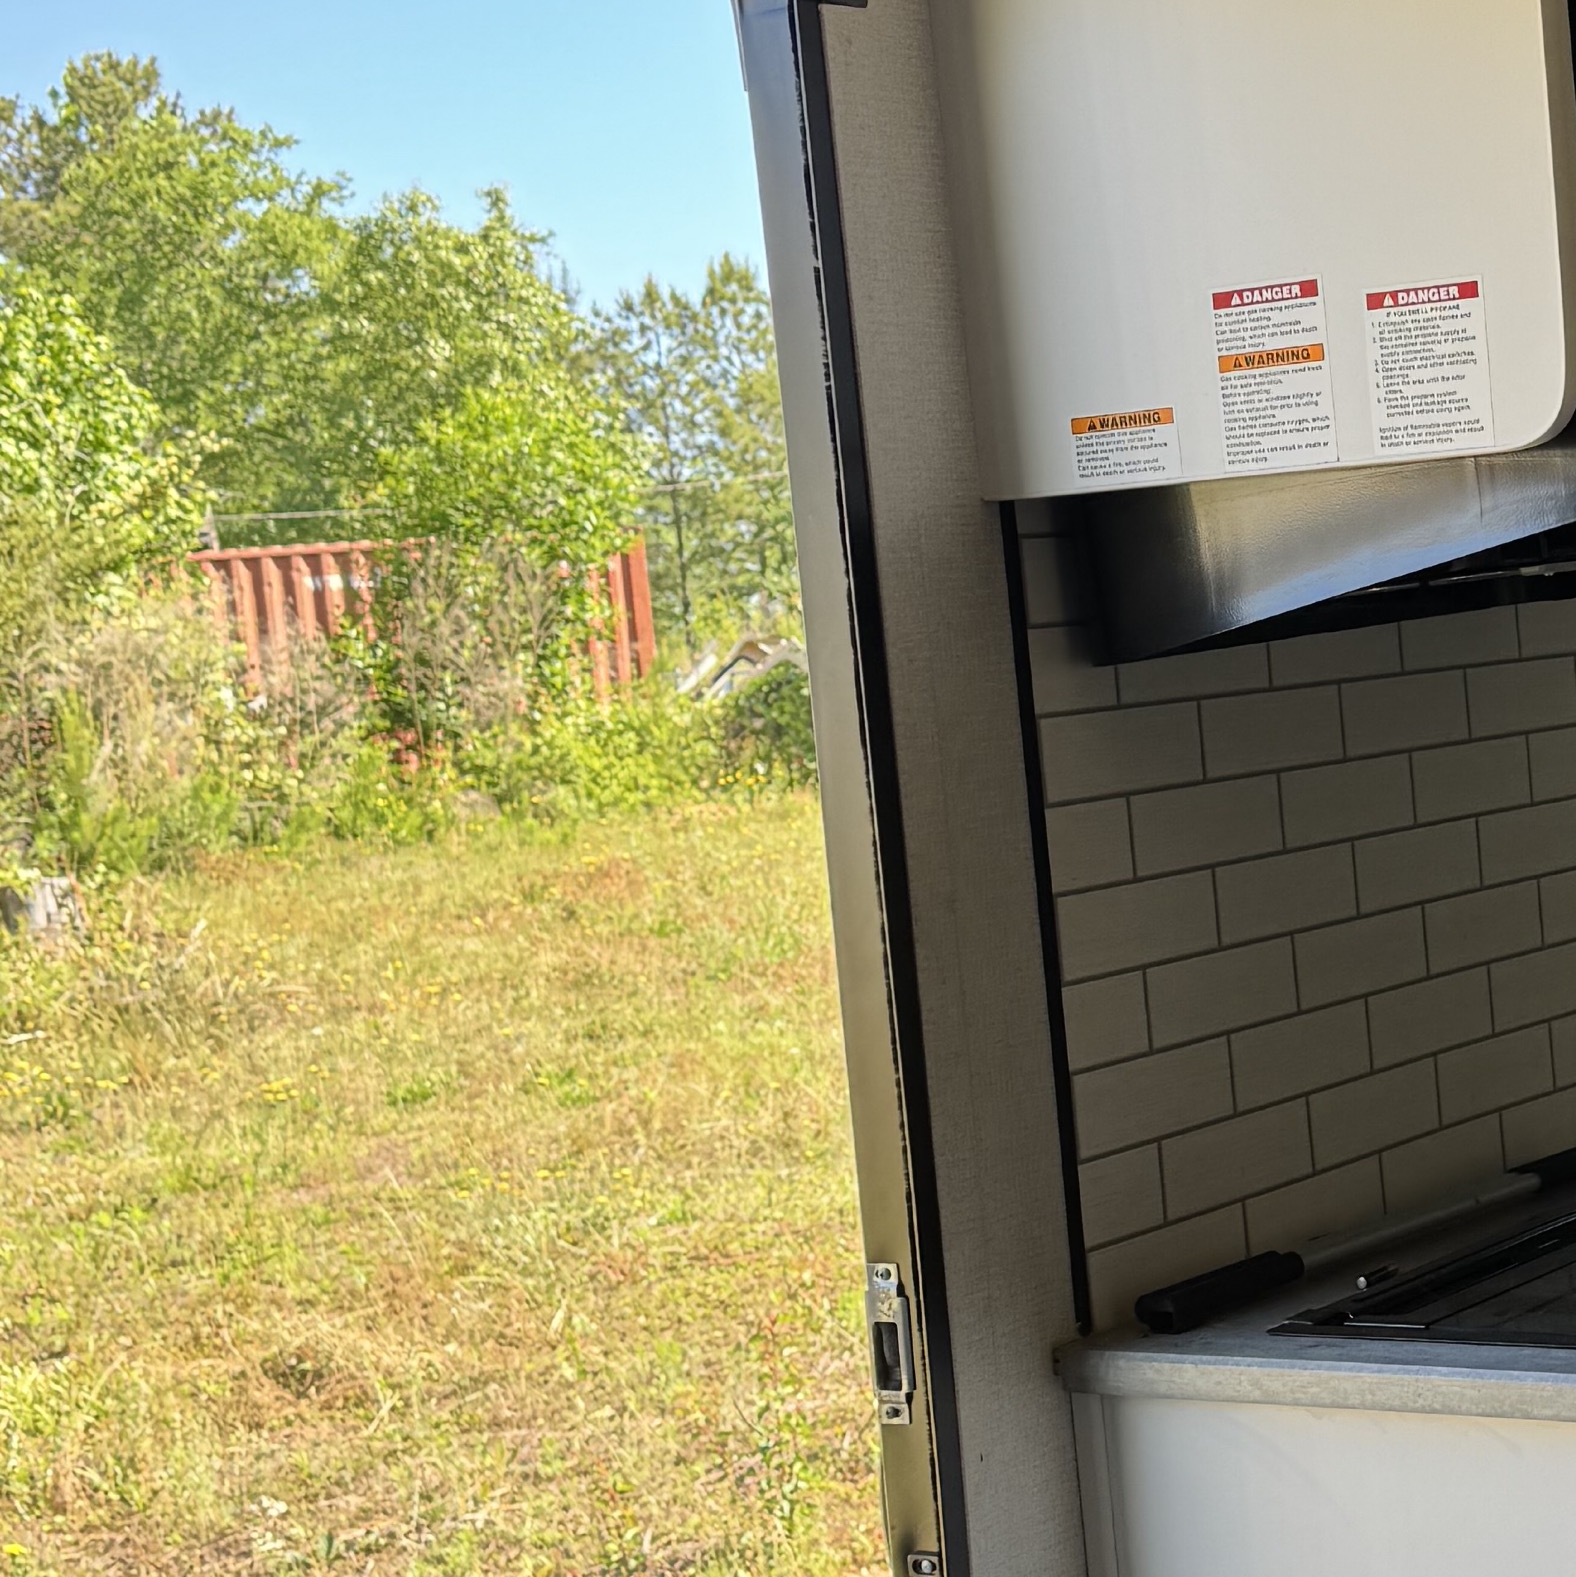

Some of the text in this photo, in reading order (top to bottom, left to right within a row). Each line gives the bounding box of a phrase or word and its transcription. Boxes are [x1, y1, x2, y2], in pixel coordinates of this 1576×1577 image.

[1242, 284, 1301, 304] DANGER
[1397, 285, 1459, 305] DANGER
[1244, 347, 1310, 367] WARNING
[1098, 411, 1161, 429] WARNING
